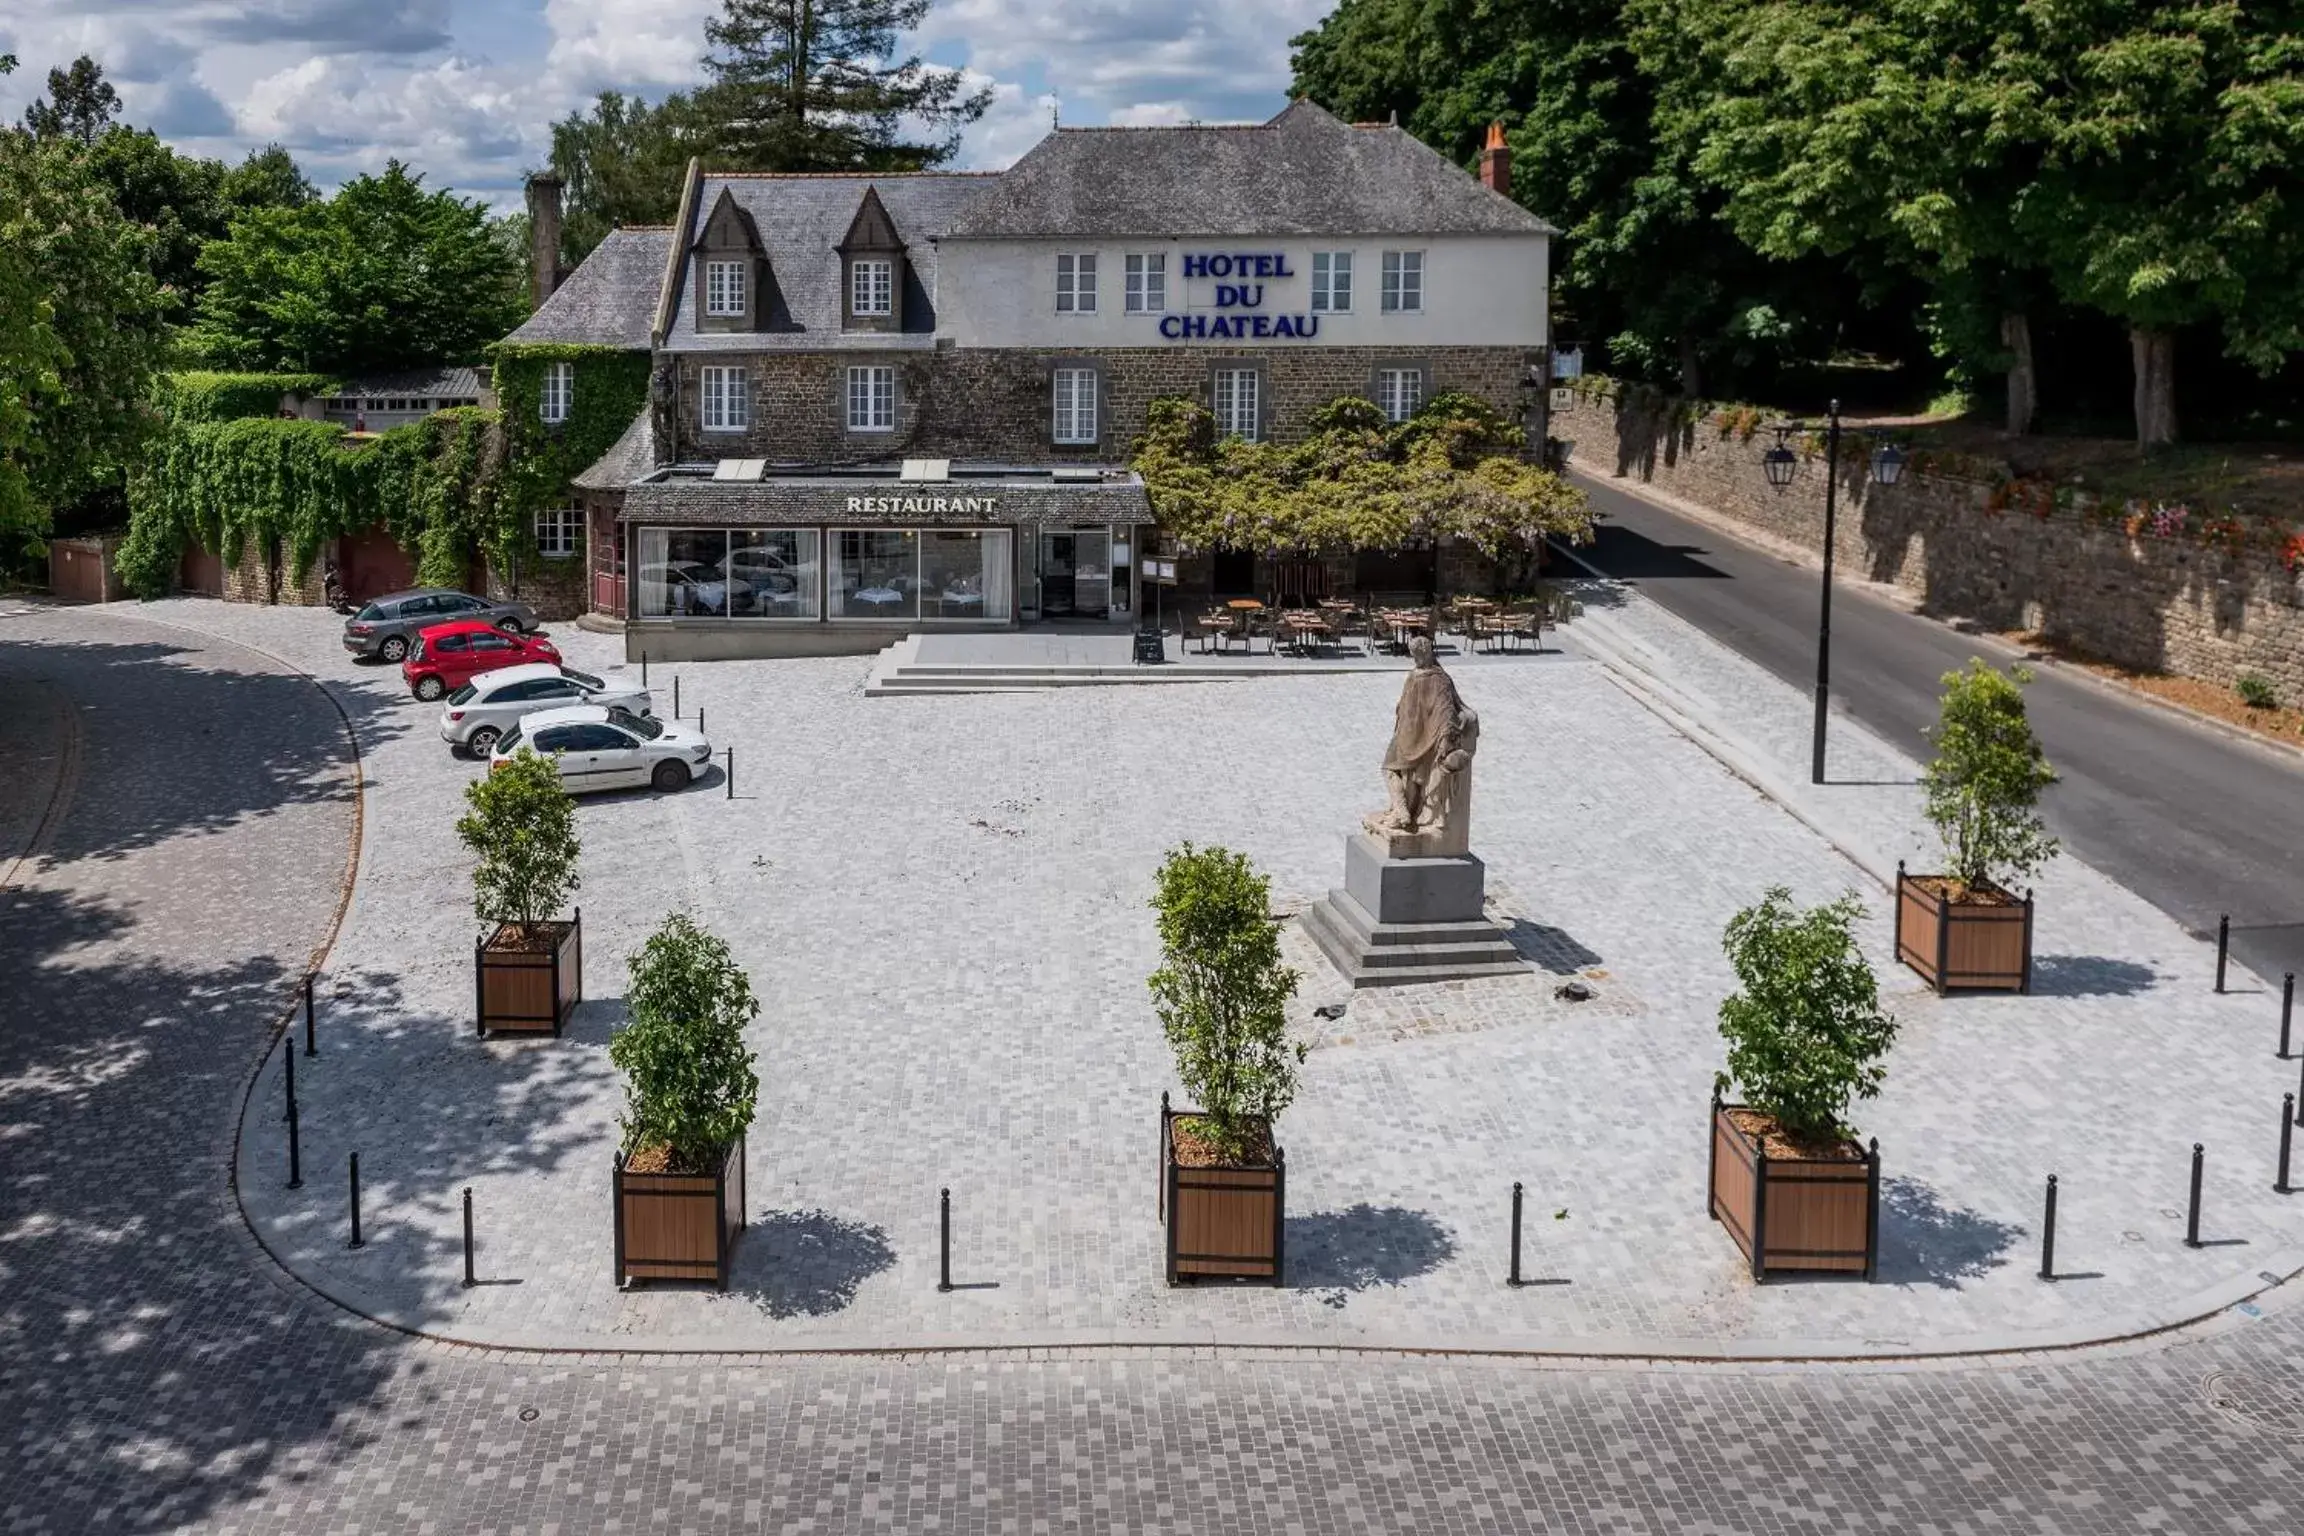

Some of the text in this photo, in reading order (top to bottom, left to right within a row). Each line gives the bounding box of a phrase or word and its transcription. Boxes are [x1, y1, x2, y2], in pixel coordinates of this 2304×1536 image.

[1183, 254, 1294, 277] HOTEL
[1216, 285, 1263, 308] DU
[1159, 315, 1318, 338] CHATEAU
[847, 497, 996, 513] RESTAURANT
